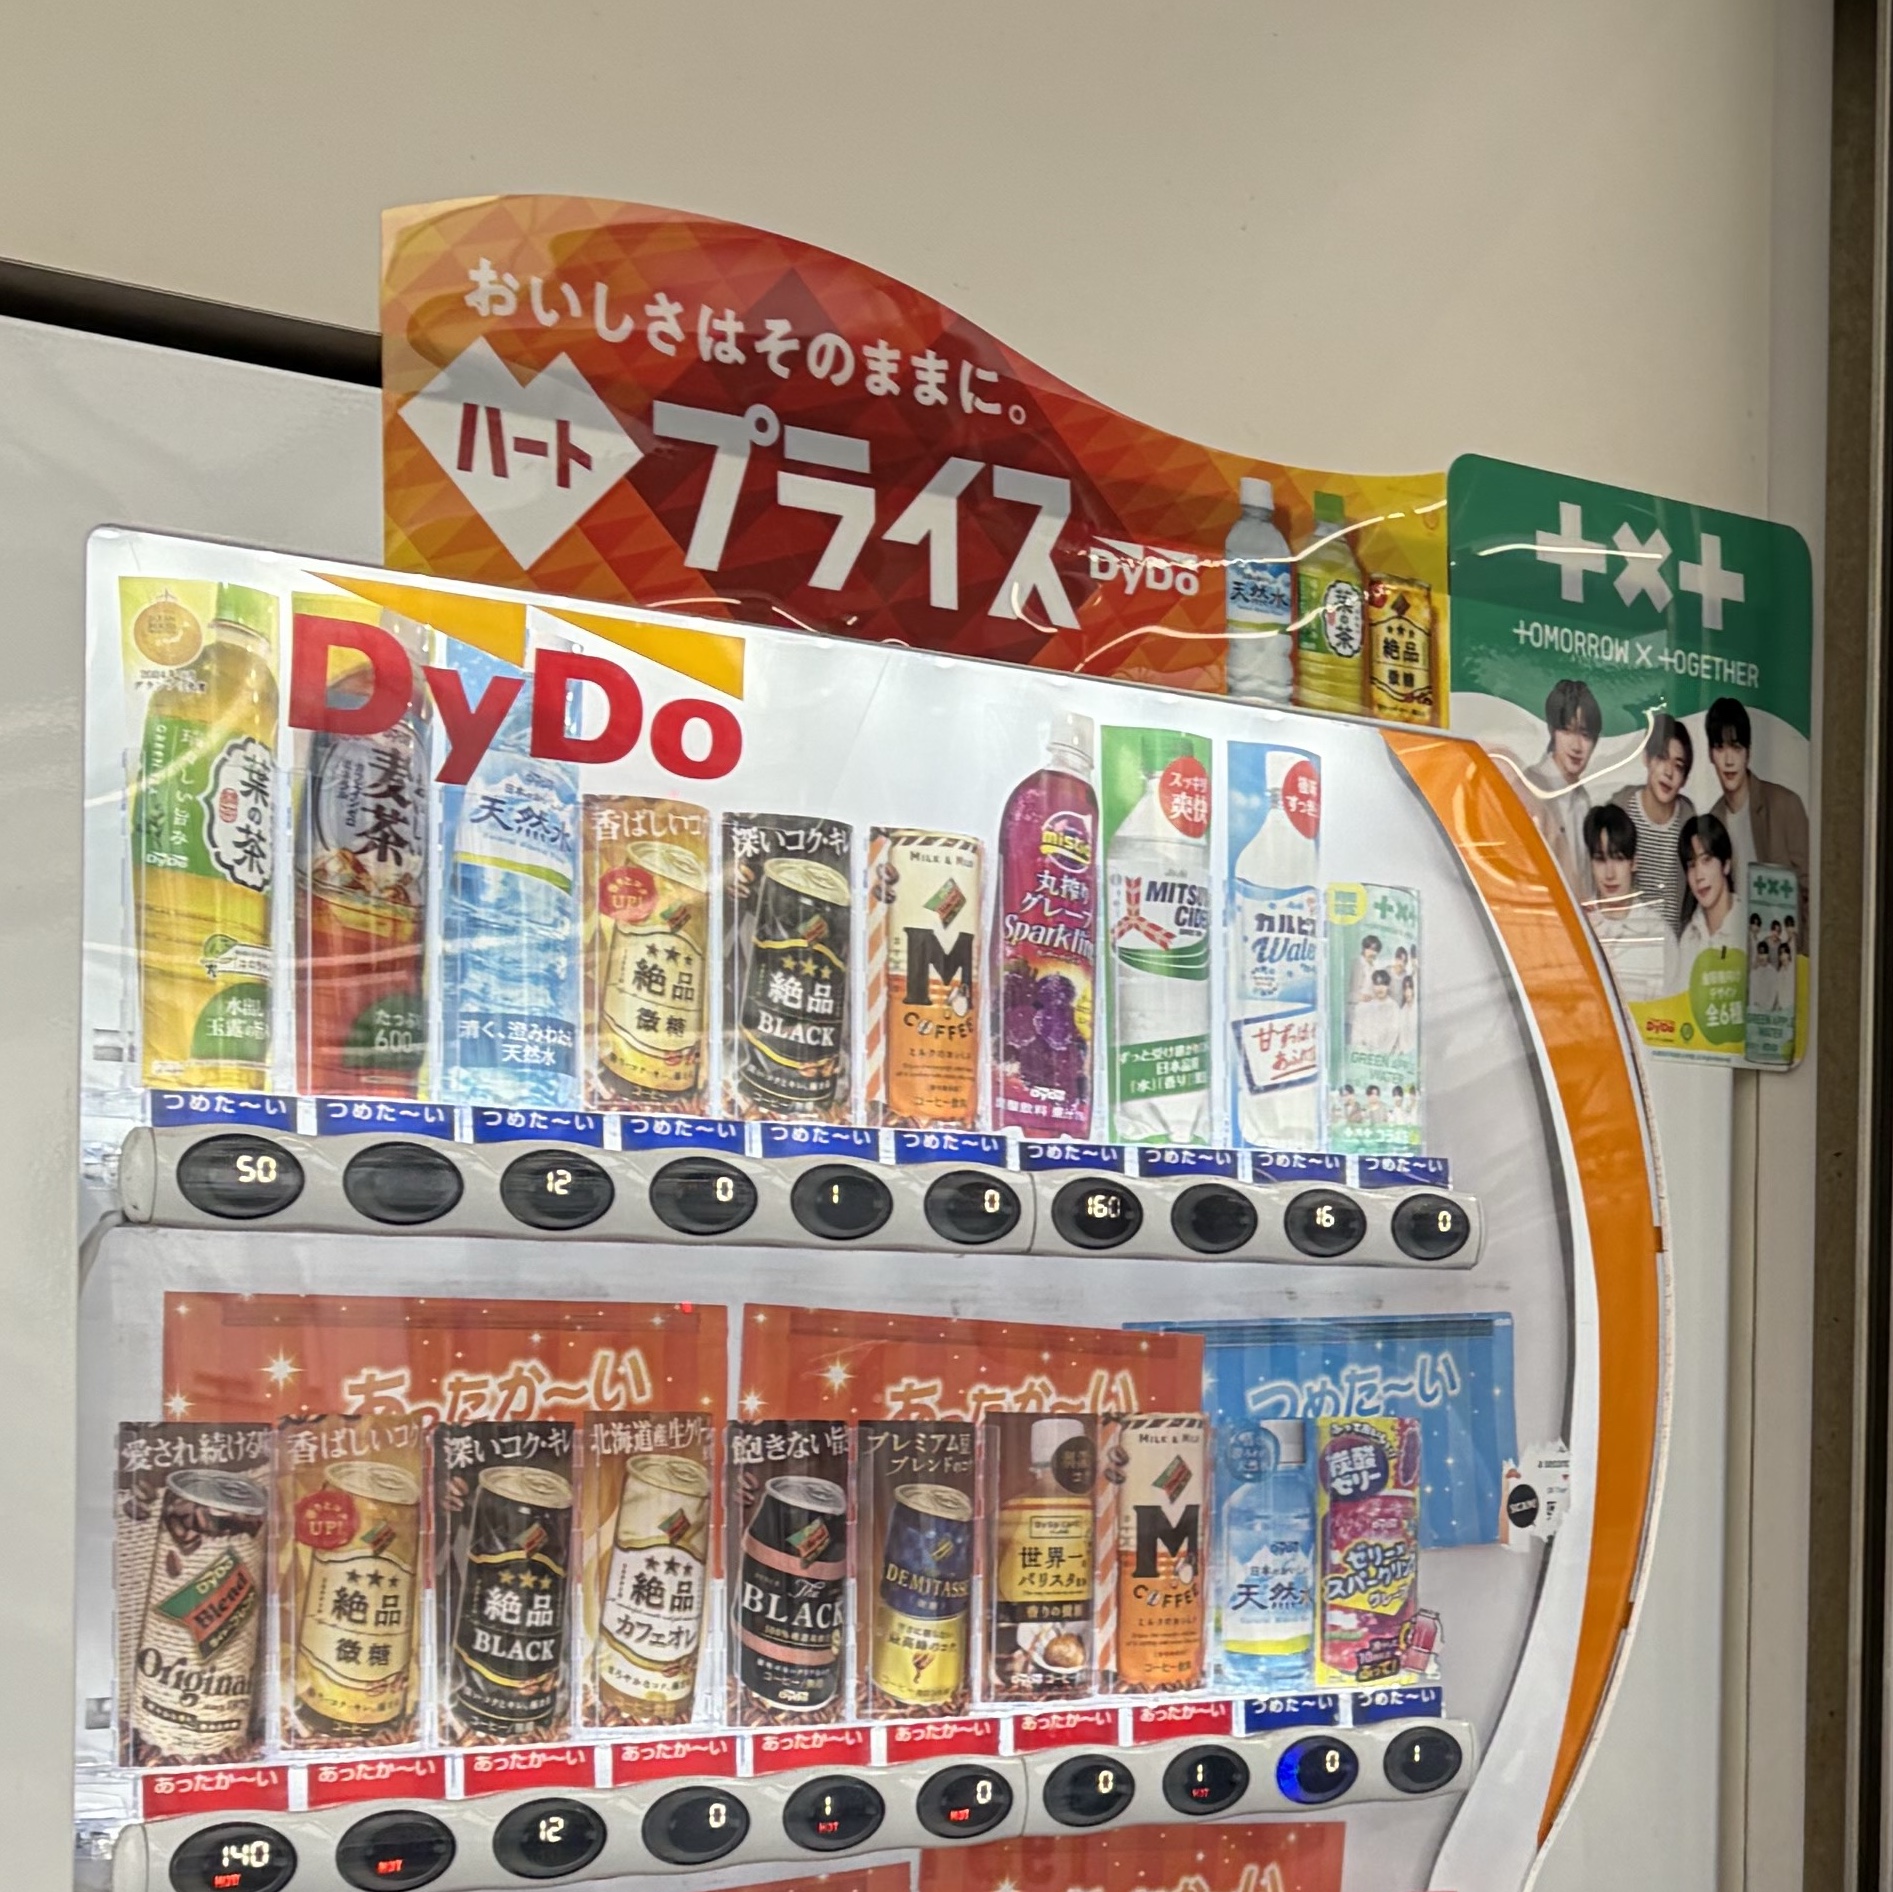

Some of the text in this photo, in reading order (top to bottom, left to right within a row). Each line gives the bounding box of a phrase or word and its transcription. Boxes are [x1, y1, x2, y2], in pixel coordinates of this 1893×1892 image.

[465, 257, 1027, 426] おいしさはそのままに。
[456, 402, 593, 489] ハート
[651, 399, 1082, 631] プライス
[1090, 540, 1201, 597] DyDo
[1229, 580, 1290, 607] 天然水
[1635, 641, 1653, 668] X
[288, 612, 743, 785] DyDo
[354, 747, 411, 868] 麦茶
[469, 794, 572, 853] 天然水
[631, 960, 695, 1002] 絶品
[768, 972, 835, 1015] 絶品
[634, 1007, 688, 1038] 微糖
[757, 1011, 836, 1047] BLACK
[501, 1044, 557, 1066] 天然水
[235, 1154, 277, 1184] 50
[1327, 1446, 1377, 1477] 炭酸
[1330, 1472, 1382, 1497] ゼリー
[309, 1519, 346, 1538] UP!
[194, 1571, 248, 1632] Blend
[331, 1585, 403, 1627] 絶品
[483, 1587, 555, 1628] 絶品
[630, 1572, 695, 1614] 絶品
[334, 1637, 393, 1668] 微糖
[472, 1628, 557, 1663] BLACK
[1325, 1748, 1340, 1773] 0
[976, 1779, 992, 1805] 0
[1098, 1769, 1114, 1794] 0
[539, 1816, 564, 1843] 12
[708, 1802, 727, 1829] 0
[223, 1840, 270, 1868] 140
